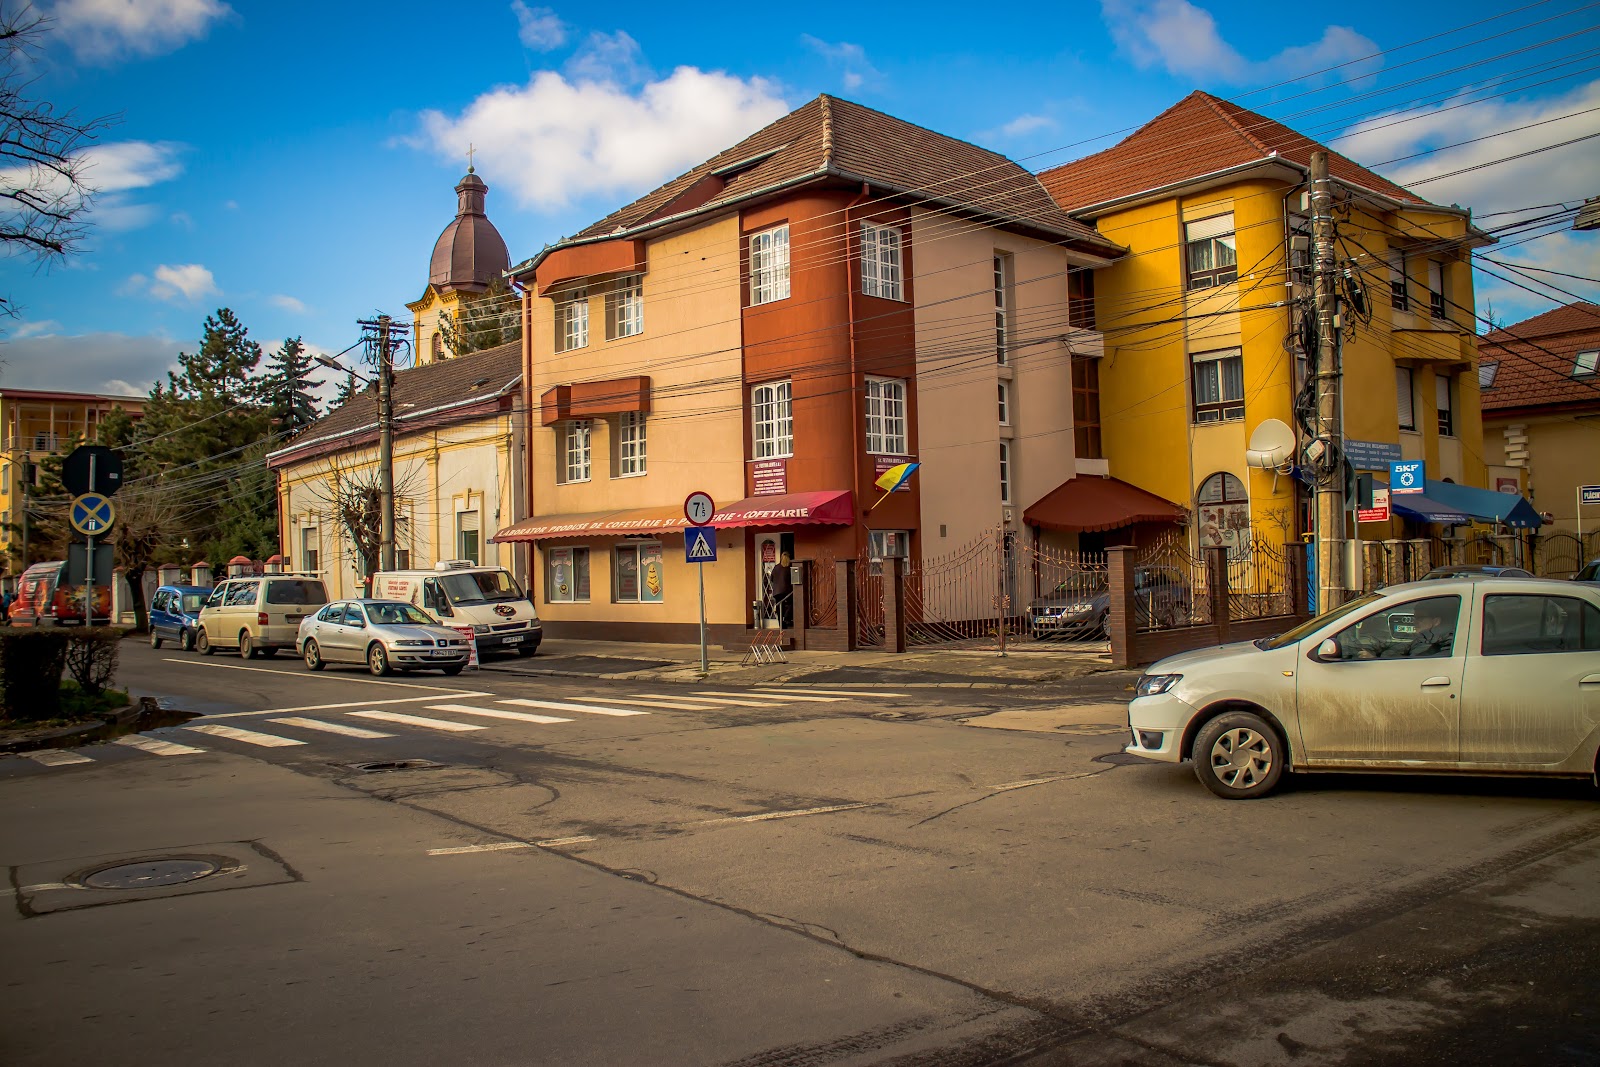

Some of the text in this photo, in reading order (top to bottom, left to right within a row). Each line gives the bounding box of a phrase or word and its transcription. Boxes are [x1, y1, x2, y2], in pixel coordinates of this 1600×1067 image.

[1395, 464, 1419, 473] SKF
[693, 502, 700, 517] 7
[498, 526, 547, 537] LABORATOR
[548, 522, 590, 532] PRODUSE
